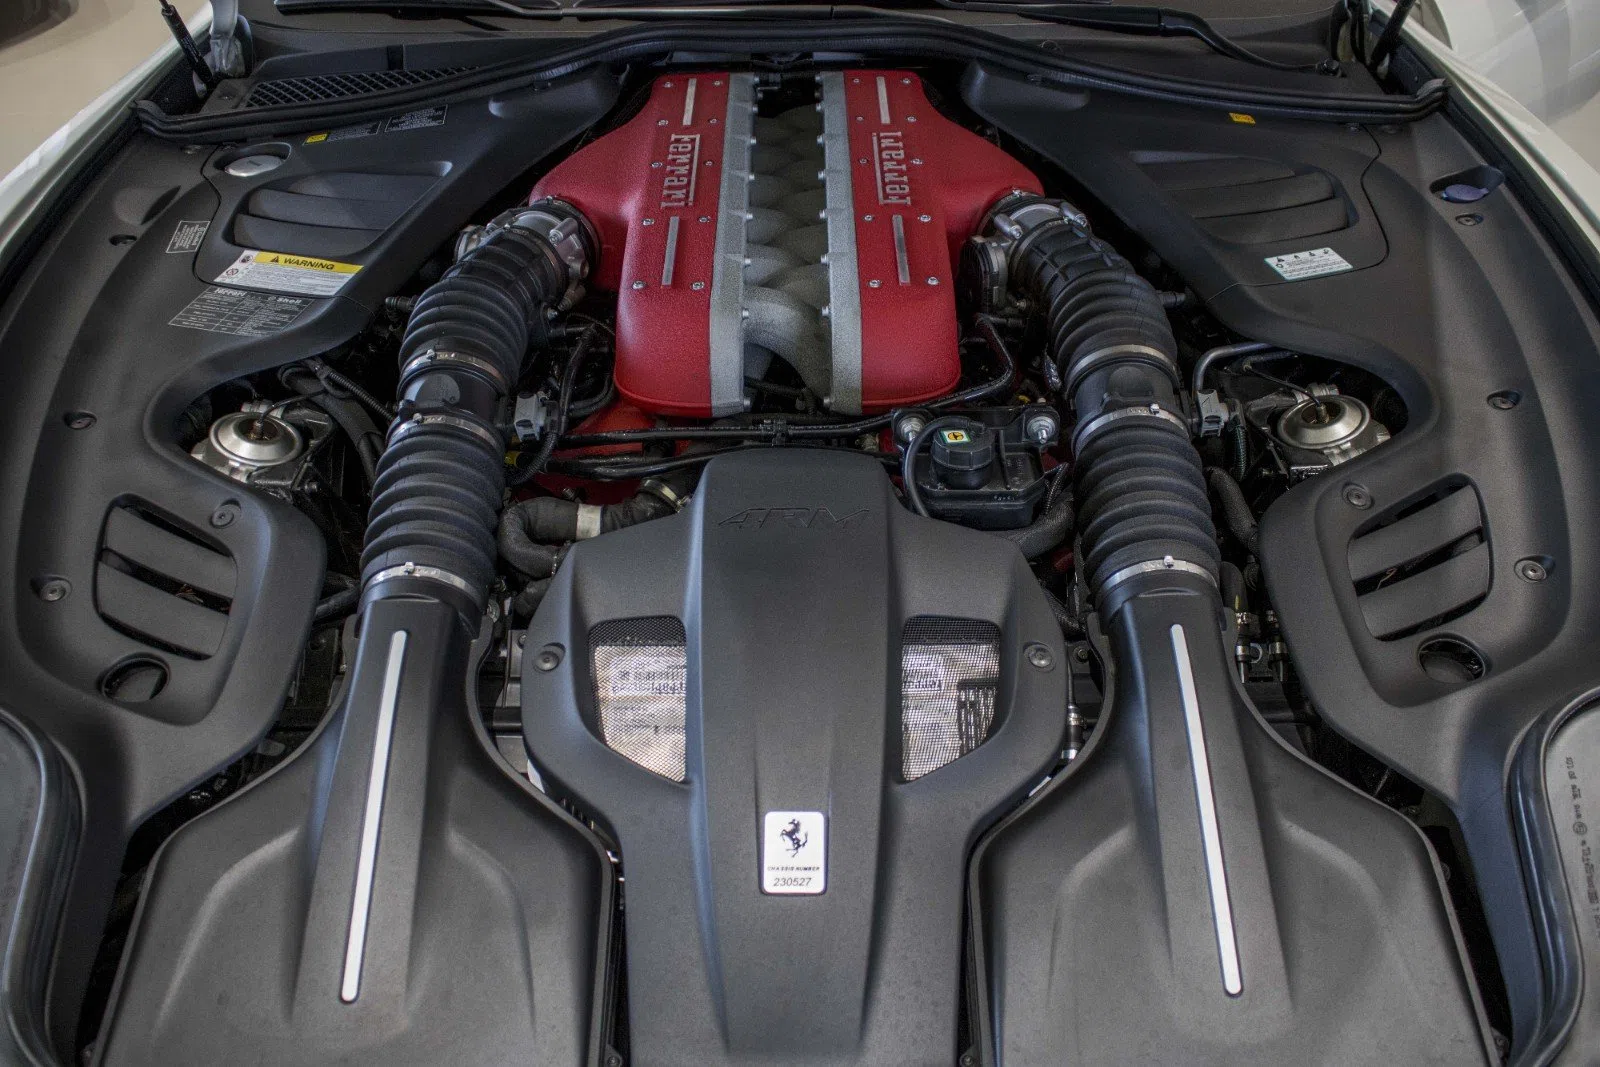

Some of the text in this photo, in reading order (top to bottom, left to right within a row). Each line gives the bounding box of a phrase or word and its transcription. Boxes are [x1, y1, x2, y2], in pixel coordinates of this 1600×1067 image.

[661, 133, 701, 209] Ferrari
[871, 131, 911, 207] Ferrari
[283, 257, 335, 270] WARNING
[277, 297, 302, 305] Shell
[773, 877, 812, 887] 230527
